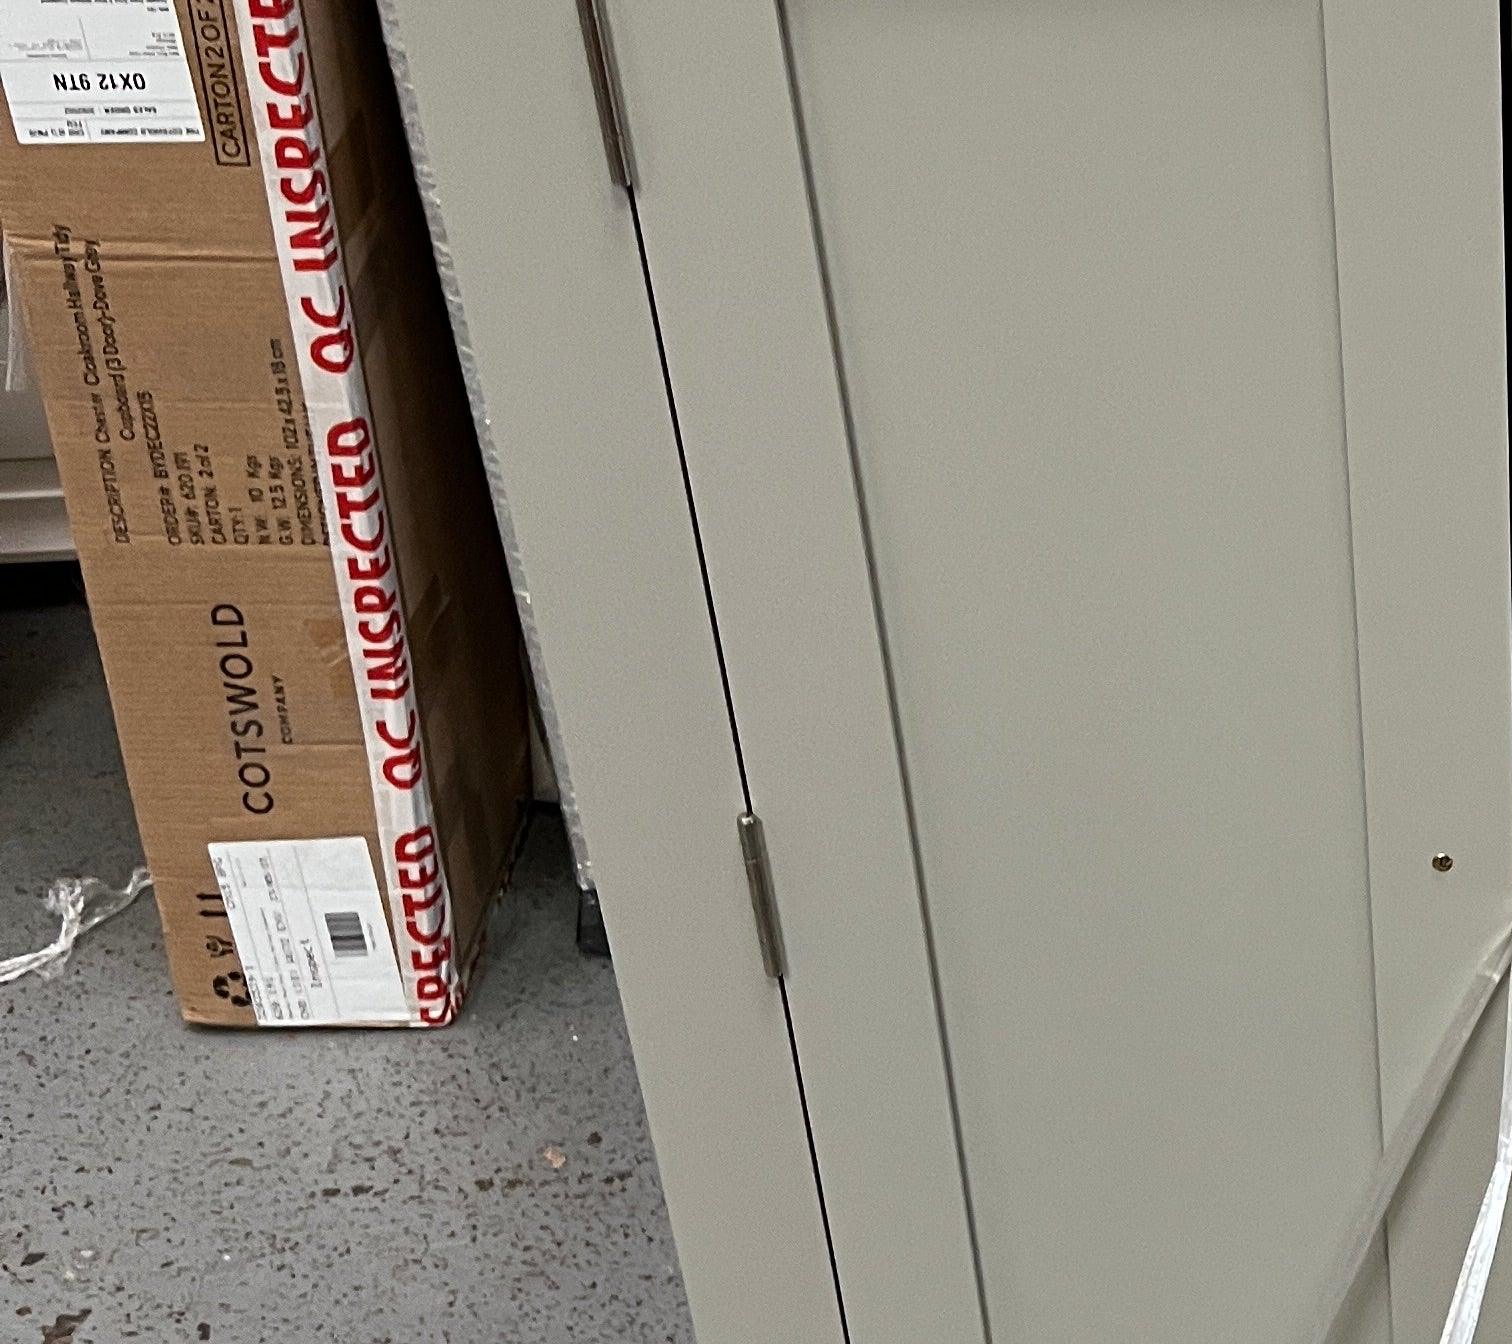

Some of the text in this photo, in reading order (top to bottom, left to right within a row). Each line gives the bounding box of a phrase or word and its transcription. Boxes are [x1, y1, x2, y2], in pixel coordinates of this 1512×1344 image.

[199, 4, 221, 45] OF
[53, 72, 146, 91] OX12 9TN
[206, 64, 241, 159] CARTON
[299, 285, 355, 375] QC
[327, 416, 424, 792] QC INSPECTED
[209, 602, 274, 815] COTSWOLD
